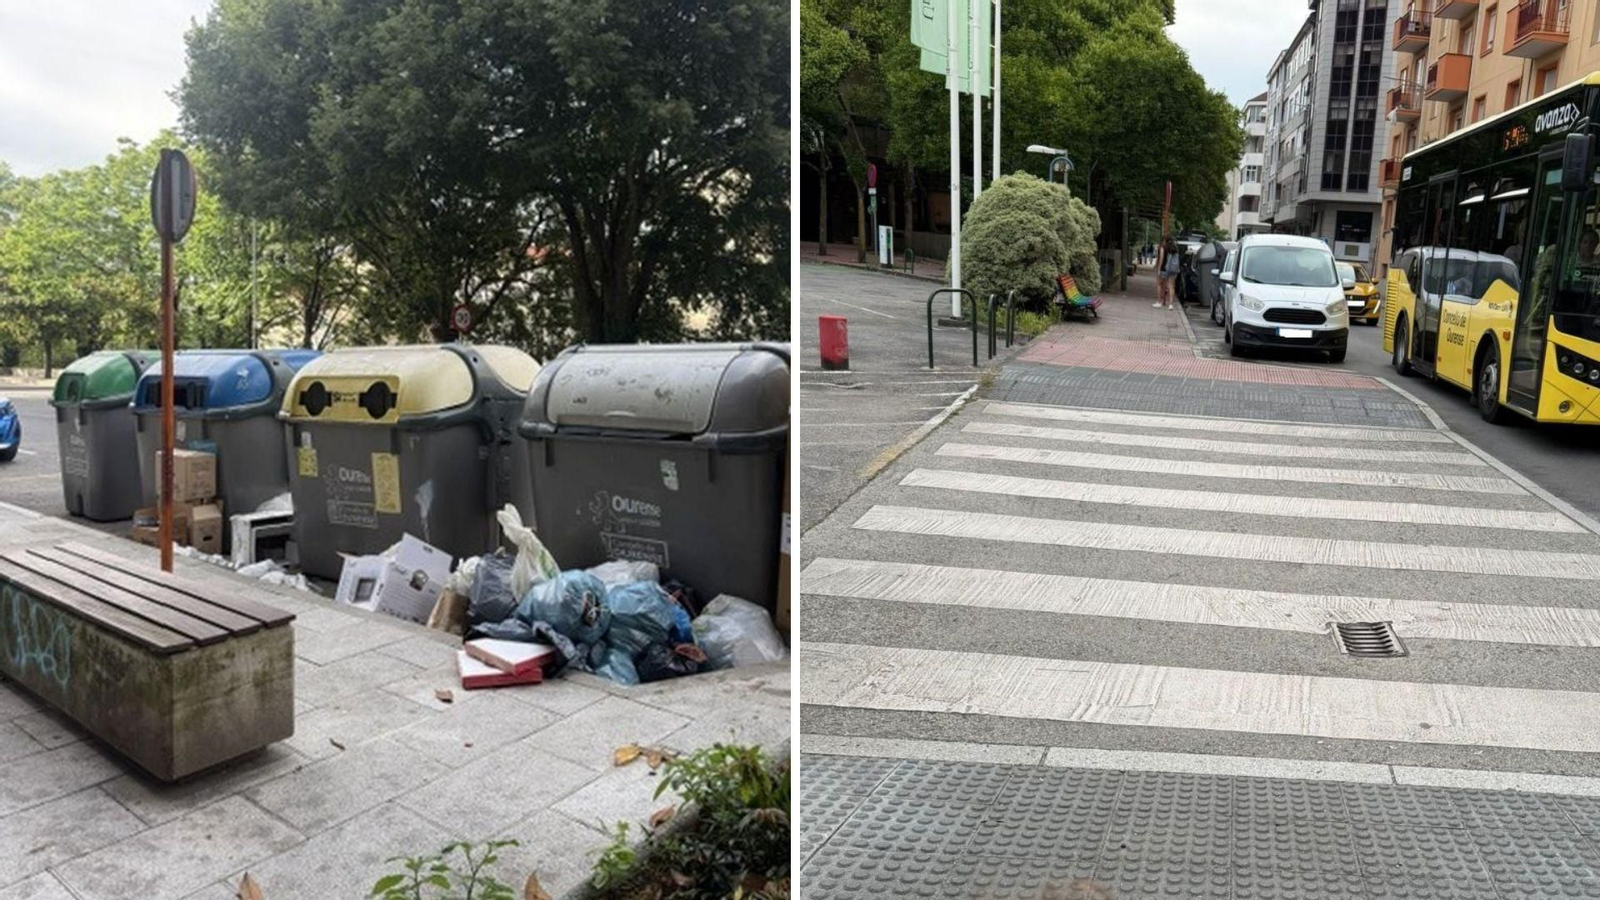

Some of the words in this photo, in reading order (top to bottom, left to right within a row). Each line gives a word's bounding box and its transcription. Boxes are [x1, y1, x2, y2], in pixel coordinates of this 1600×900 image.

[1535, 103, 1571, 133] avanza
[1447, 327, 1464, 346] Ourense
[612, 495, 661, 517] Ourense
